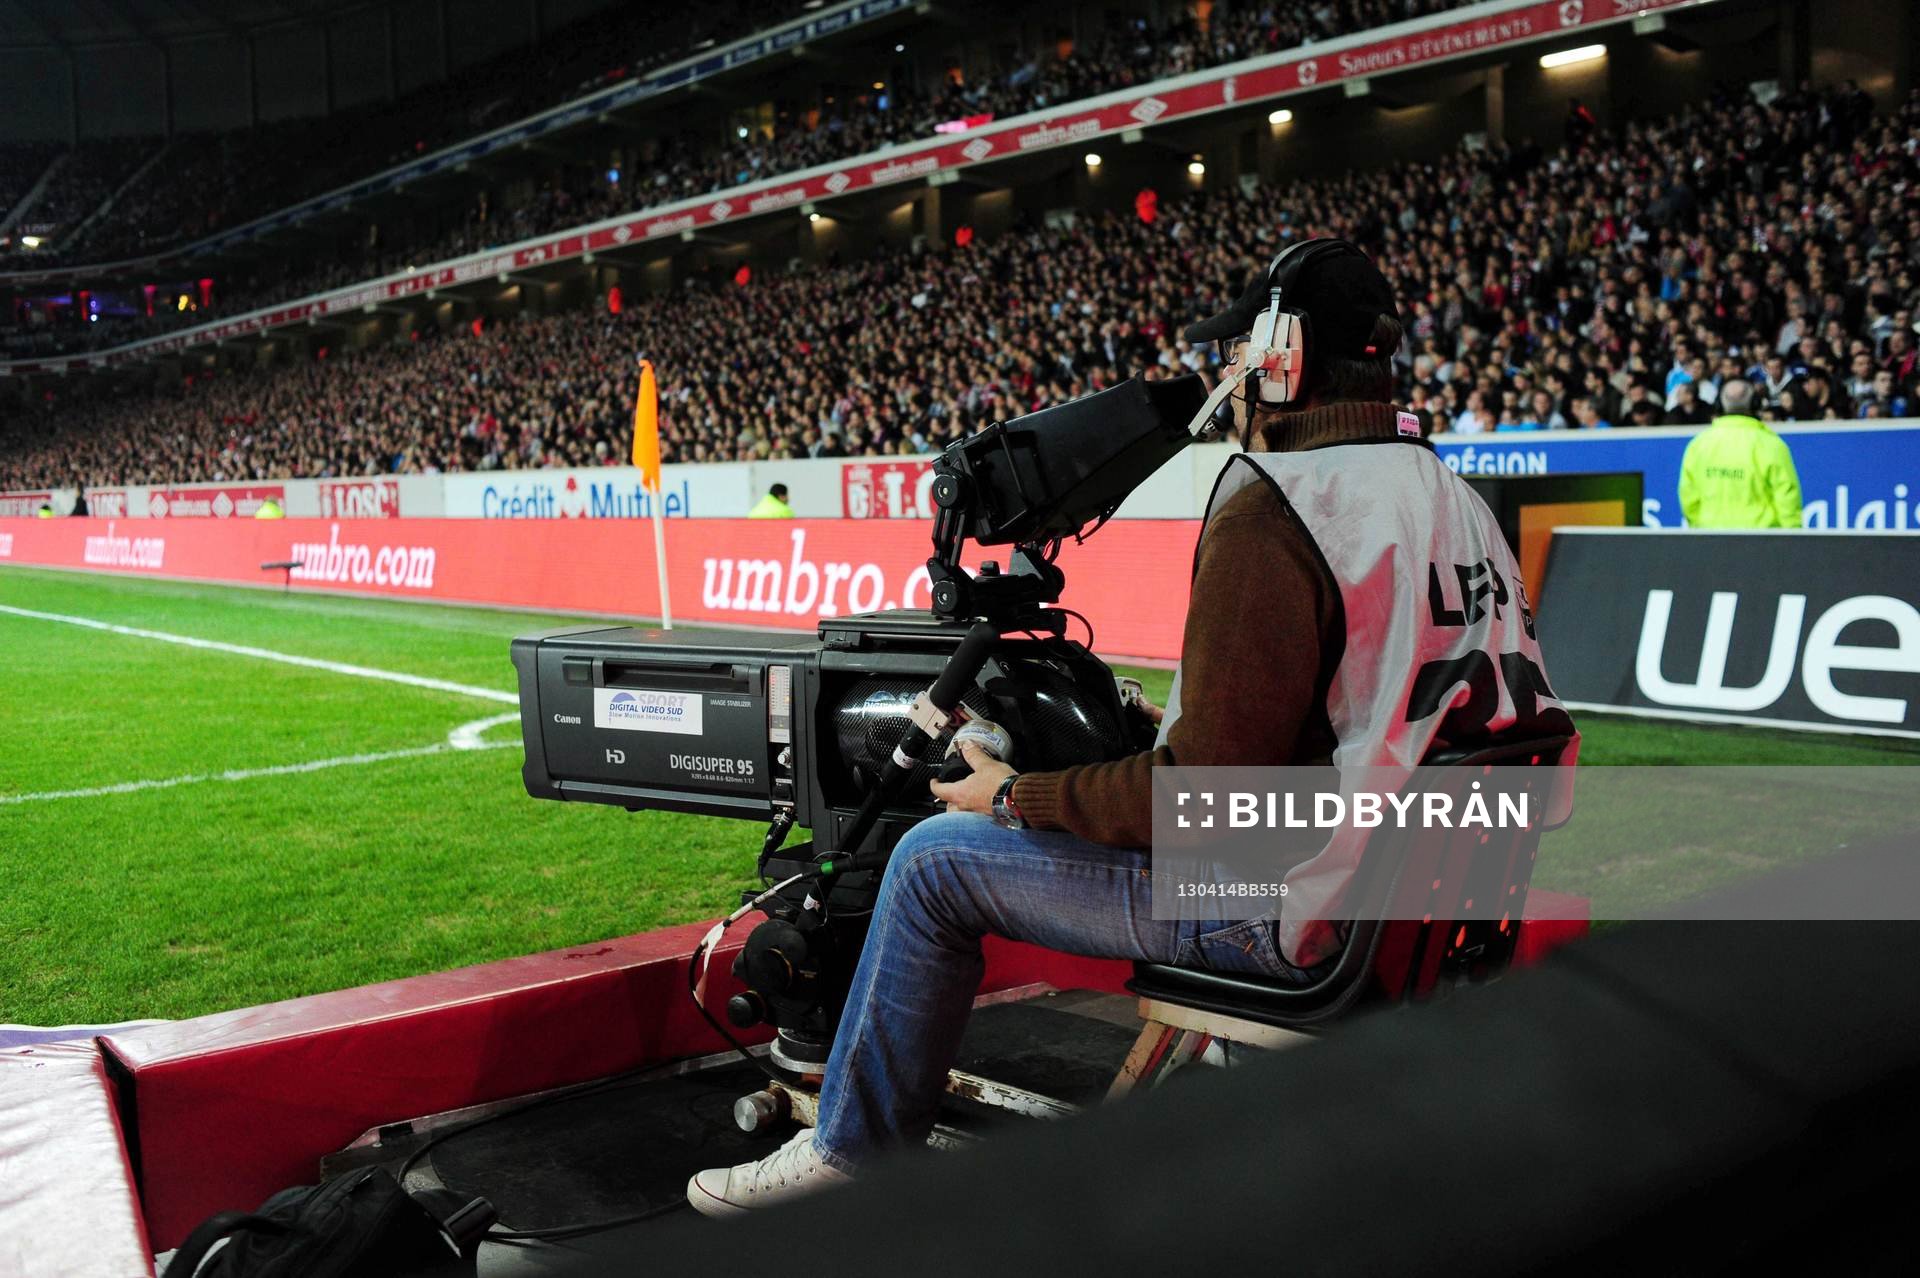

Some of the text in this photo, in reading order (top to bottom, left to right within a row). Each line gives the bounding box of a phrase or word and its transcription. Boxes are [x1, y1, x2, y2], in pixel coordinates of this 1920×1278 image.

[483, 484, 555, 518] Crédit
[1801, 484, 1920, 529] alai
[84, 521, 165, 568] umbro.com
[290, 523, 436, 588] umbro.com
[703, 528, 985, 616] umbro.c
[554, 713, 581, 725] Canon
[609, 702, 683, 716] DIGITAL VIDEO SUD
[606, 749, 625, 764] HD
[670, 754, 754, 776] DIGISUPER 95
